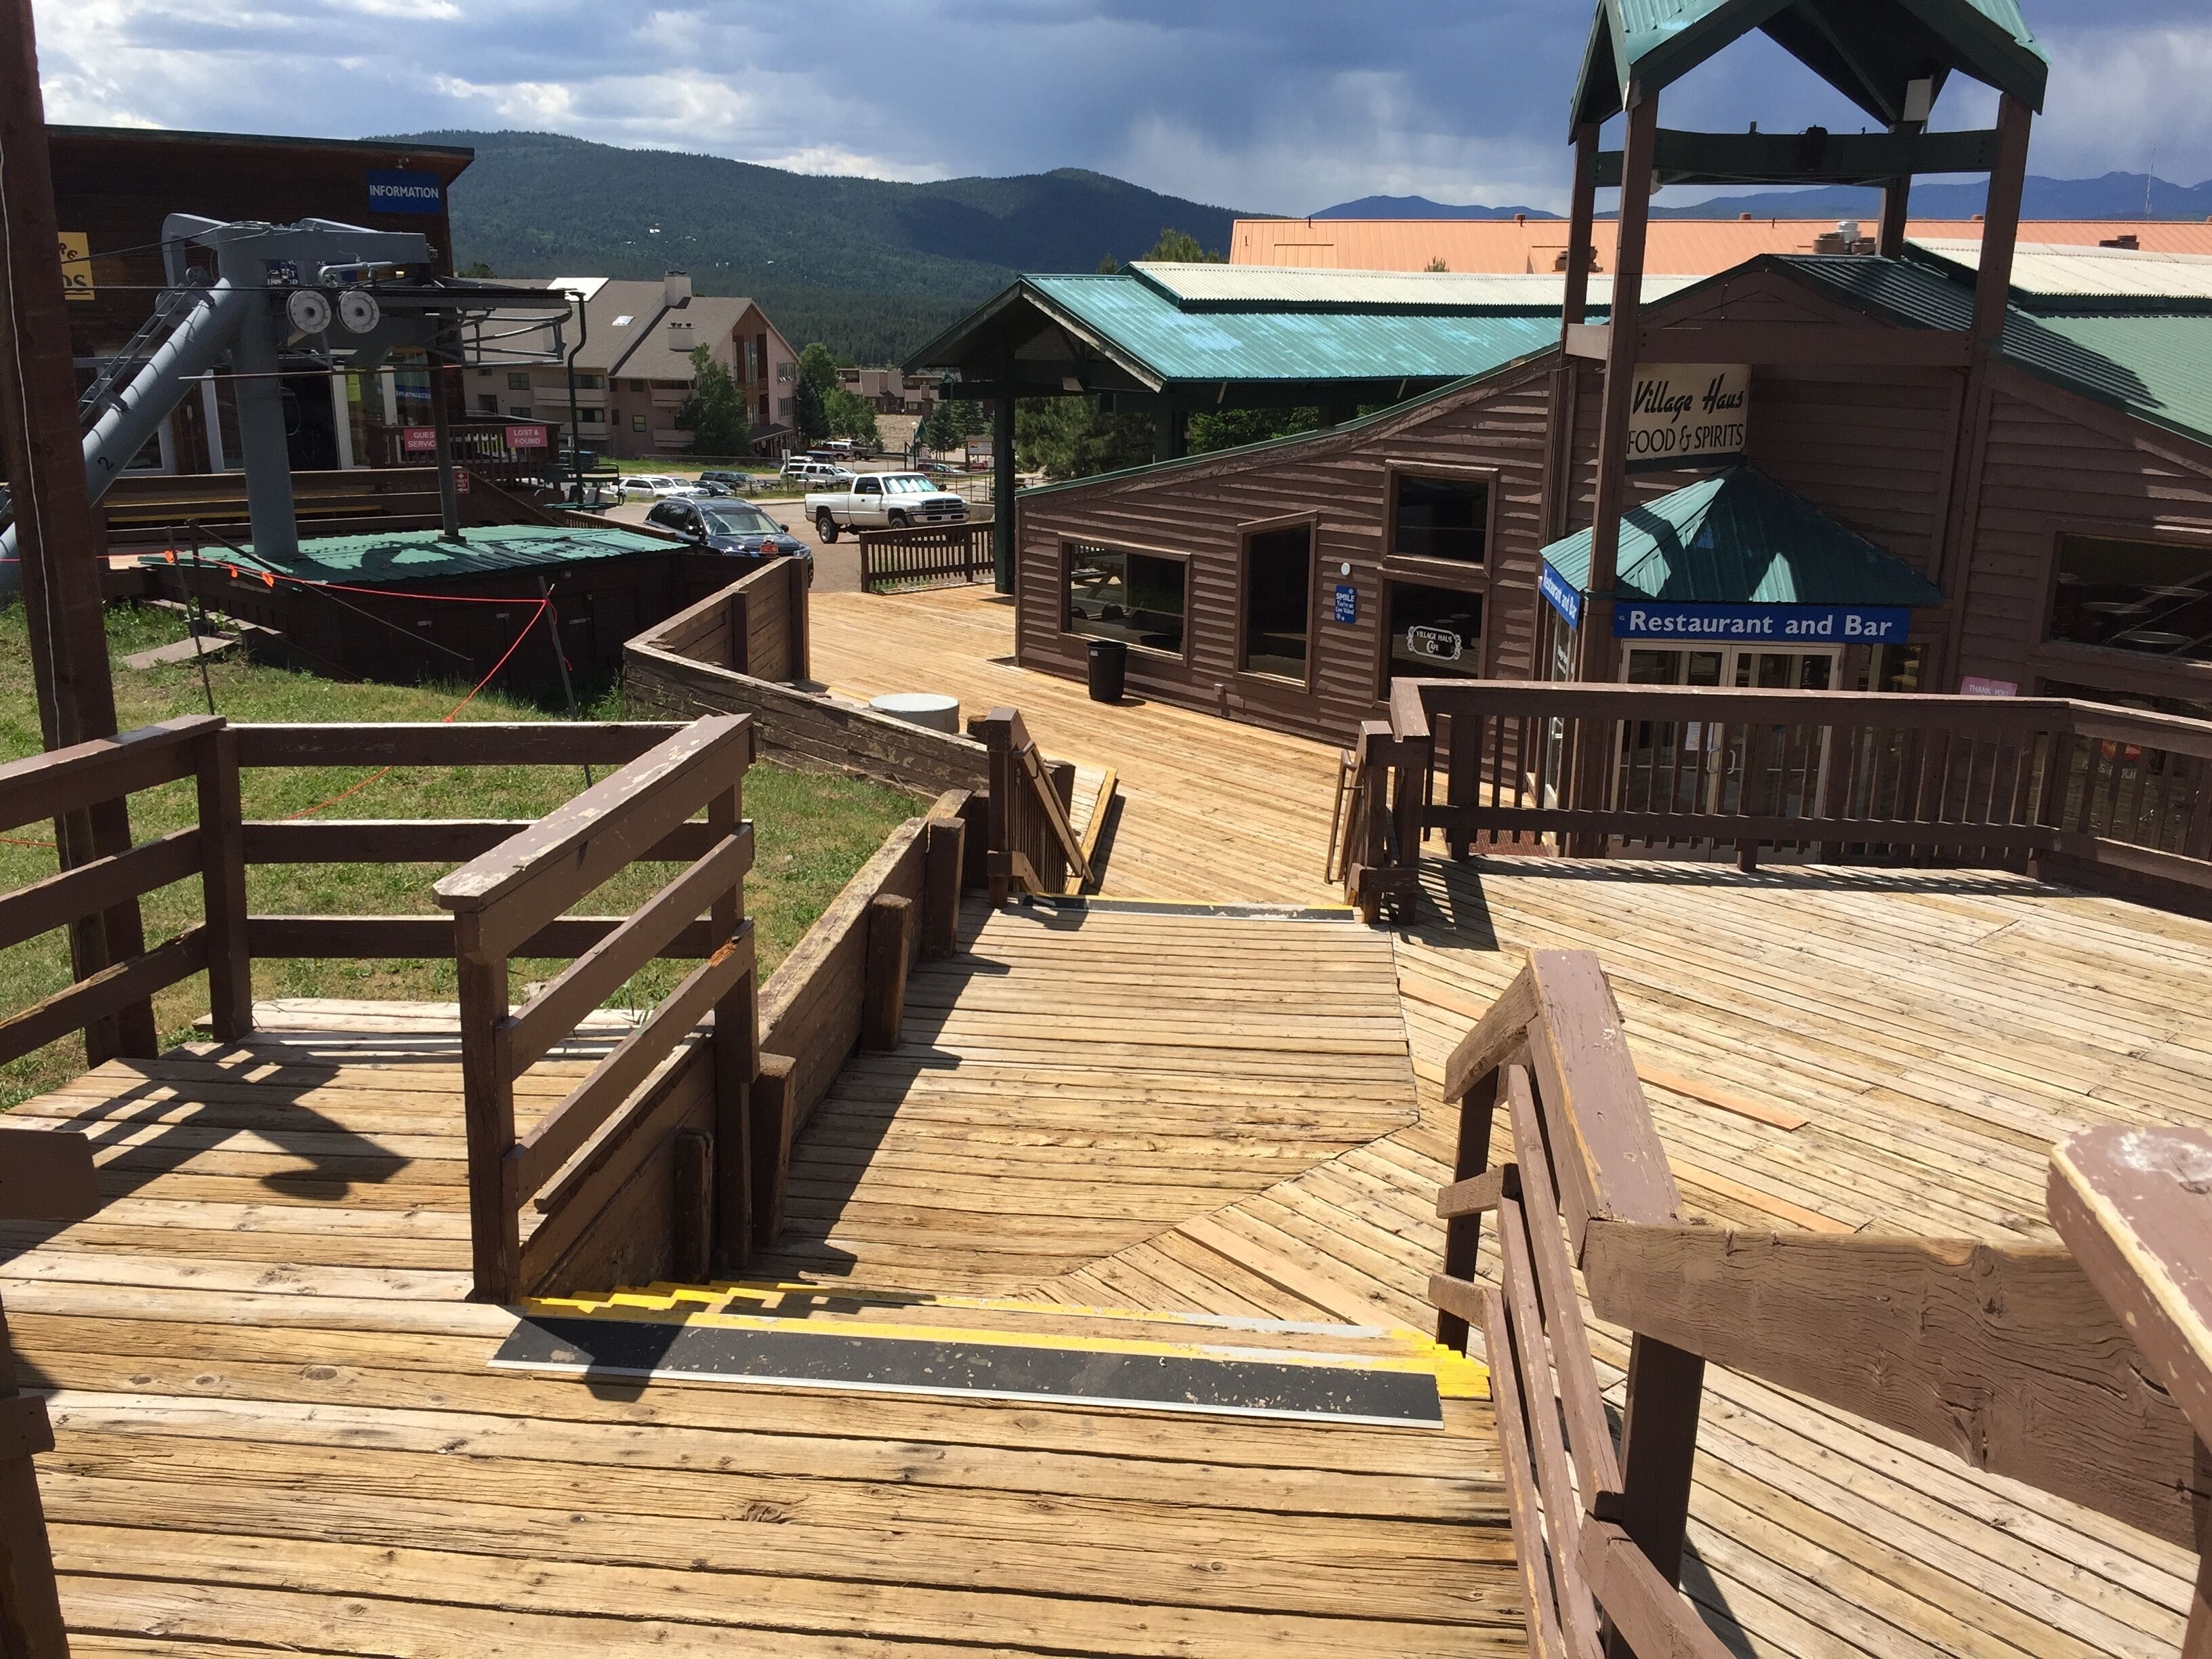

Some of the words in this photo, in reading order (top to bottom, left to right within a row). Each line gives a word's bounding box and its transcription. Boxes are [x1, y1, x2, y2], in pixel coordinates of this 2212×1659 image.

[369, 184, 439, 199] INFORMATION
[1633, 380, 1693, 424] Village
[1702, 373, 1744, 415] Haus
[1626, 428, 1676, 454] FOOD
[1679, 425, 1692, 452] &
[1694, 423, 1744, 449] SPIRITS
[98, 457, 114, 471] 2
[1336, 592, 1355, 602] SMILE
[1629, 611, 1773, 634] Restaurant
[1784, 615, 1833, 635] and
[1844, 615, 1893, 636] Bar
[1416, 630, 1436, 640] VILLAGE
[1437, 634, 1452, 643] HAUS
[1969, 684, 1991, 695] THANK
[1994, 689, 2009, 697] YOU
